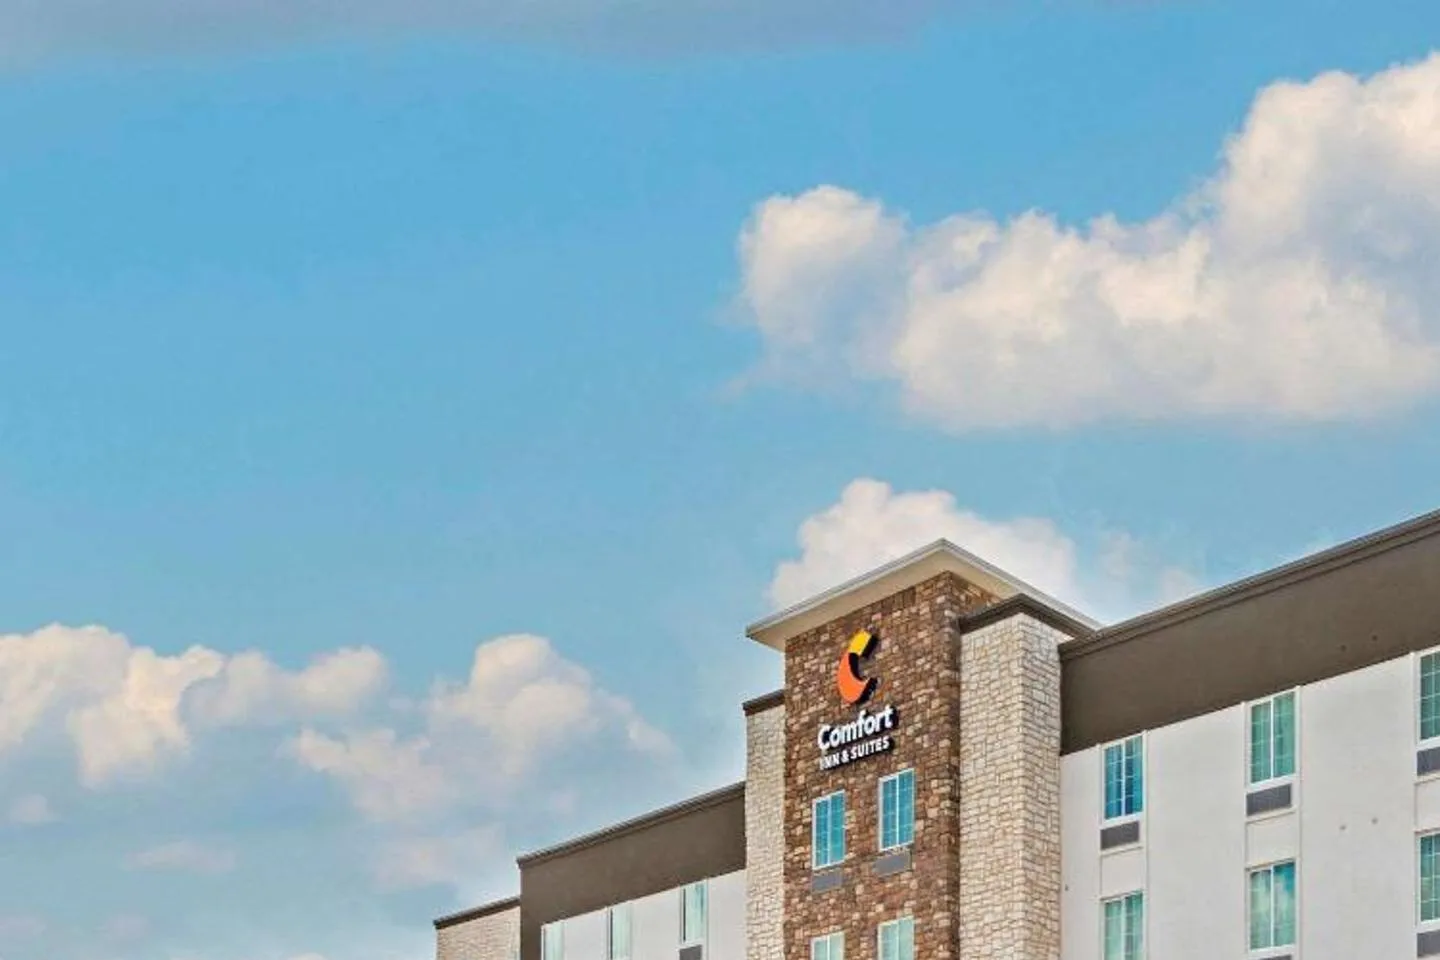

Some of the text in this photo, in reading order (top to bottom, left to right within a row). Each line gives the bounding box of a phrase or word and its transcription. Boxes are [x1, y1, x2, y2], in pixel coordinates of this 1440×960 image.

[818, 704, 893, 750] Comfort
[820, 736, 890, 770] INN & SUITES
